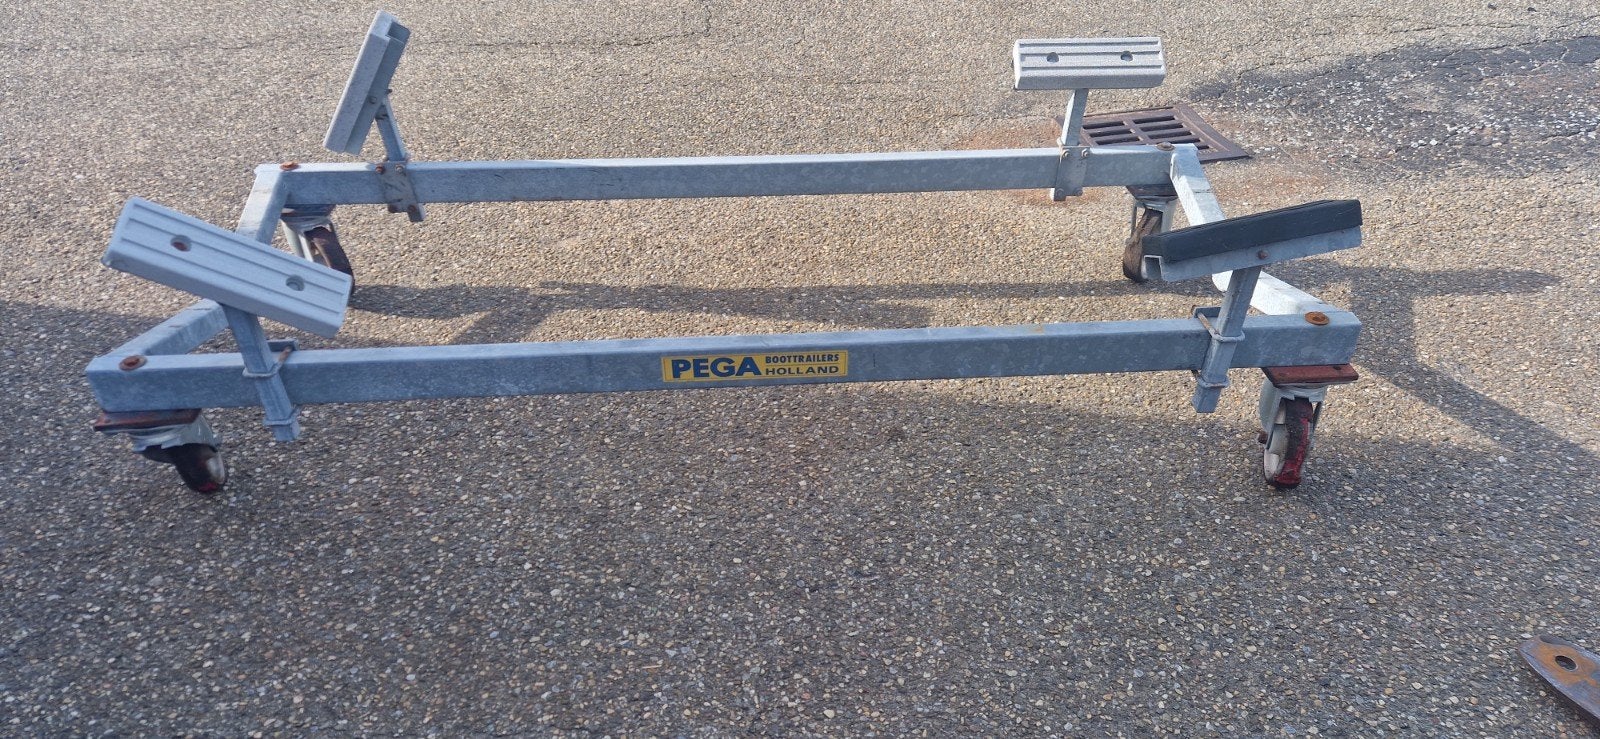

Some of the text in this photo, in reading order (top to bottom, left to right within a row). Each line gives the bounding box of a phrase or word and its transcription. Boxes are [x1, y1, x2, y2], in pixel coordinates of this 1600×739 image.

[765, 353, 840, 364] BOOTTRAILERS
[671, 356, 762, 378] PEGA
[765, 365, 839, 375] HOLLAND
